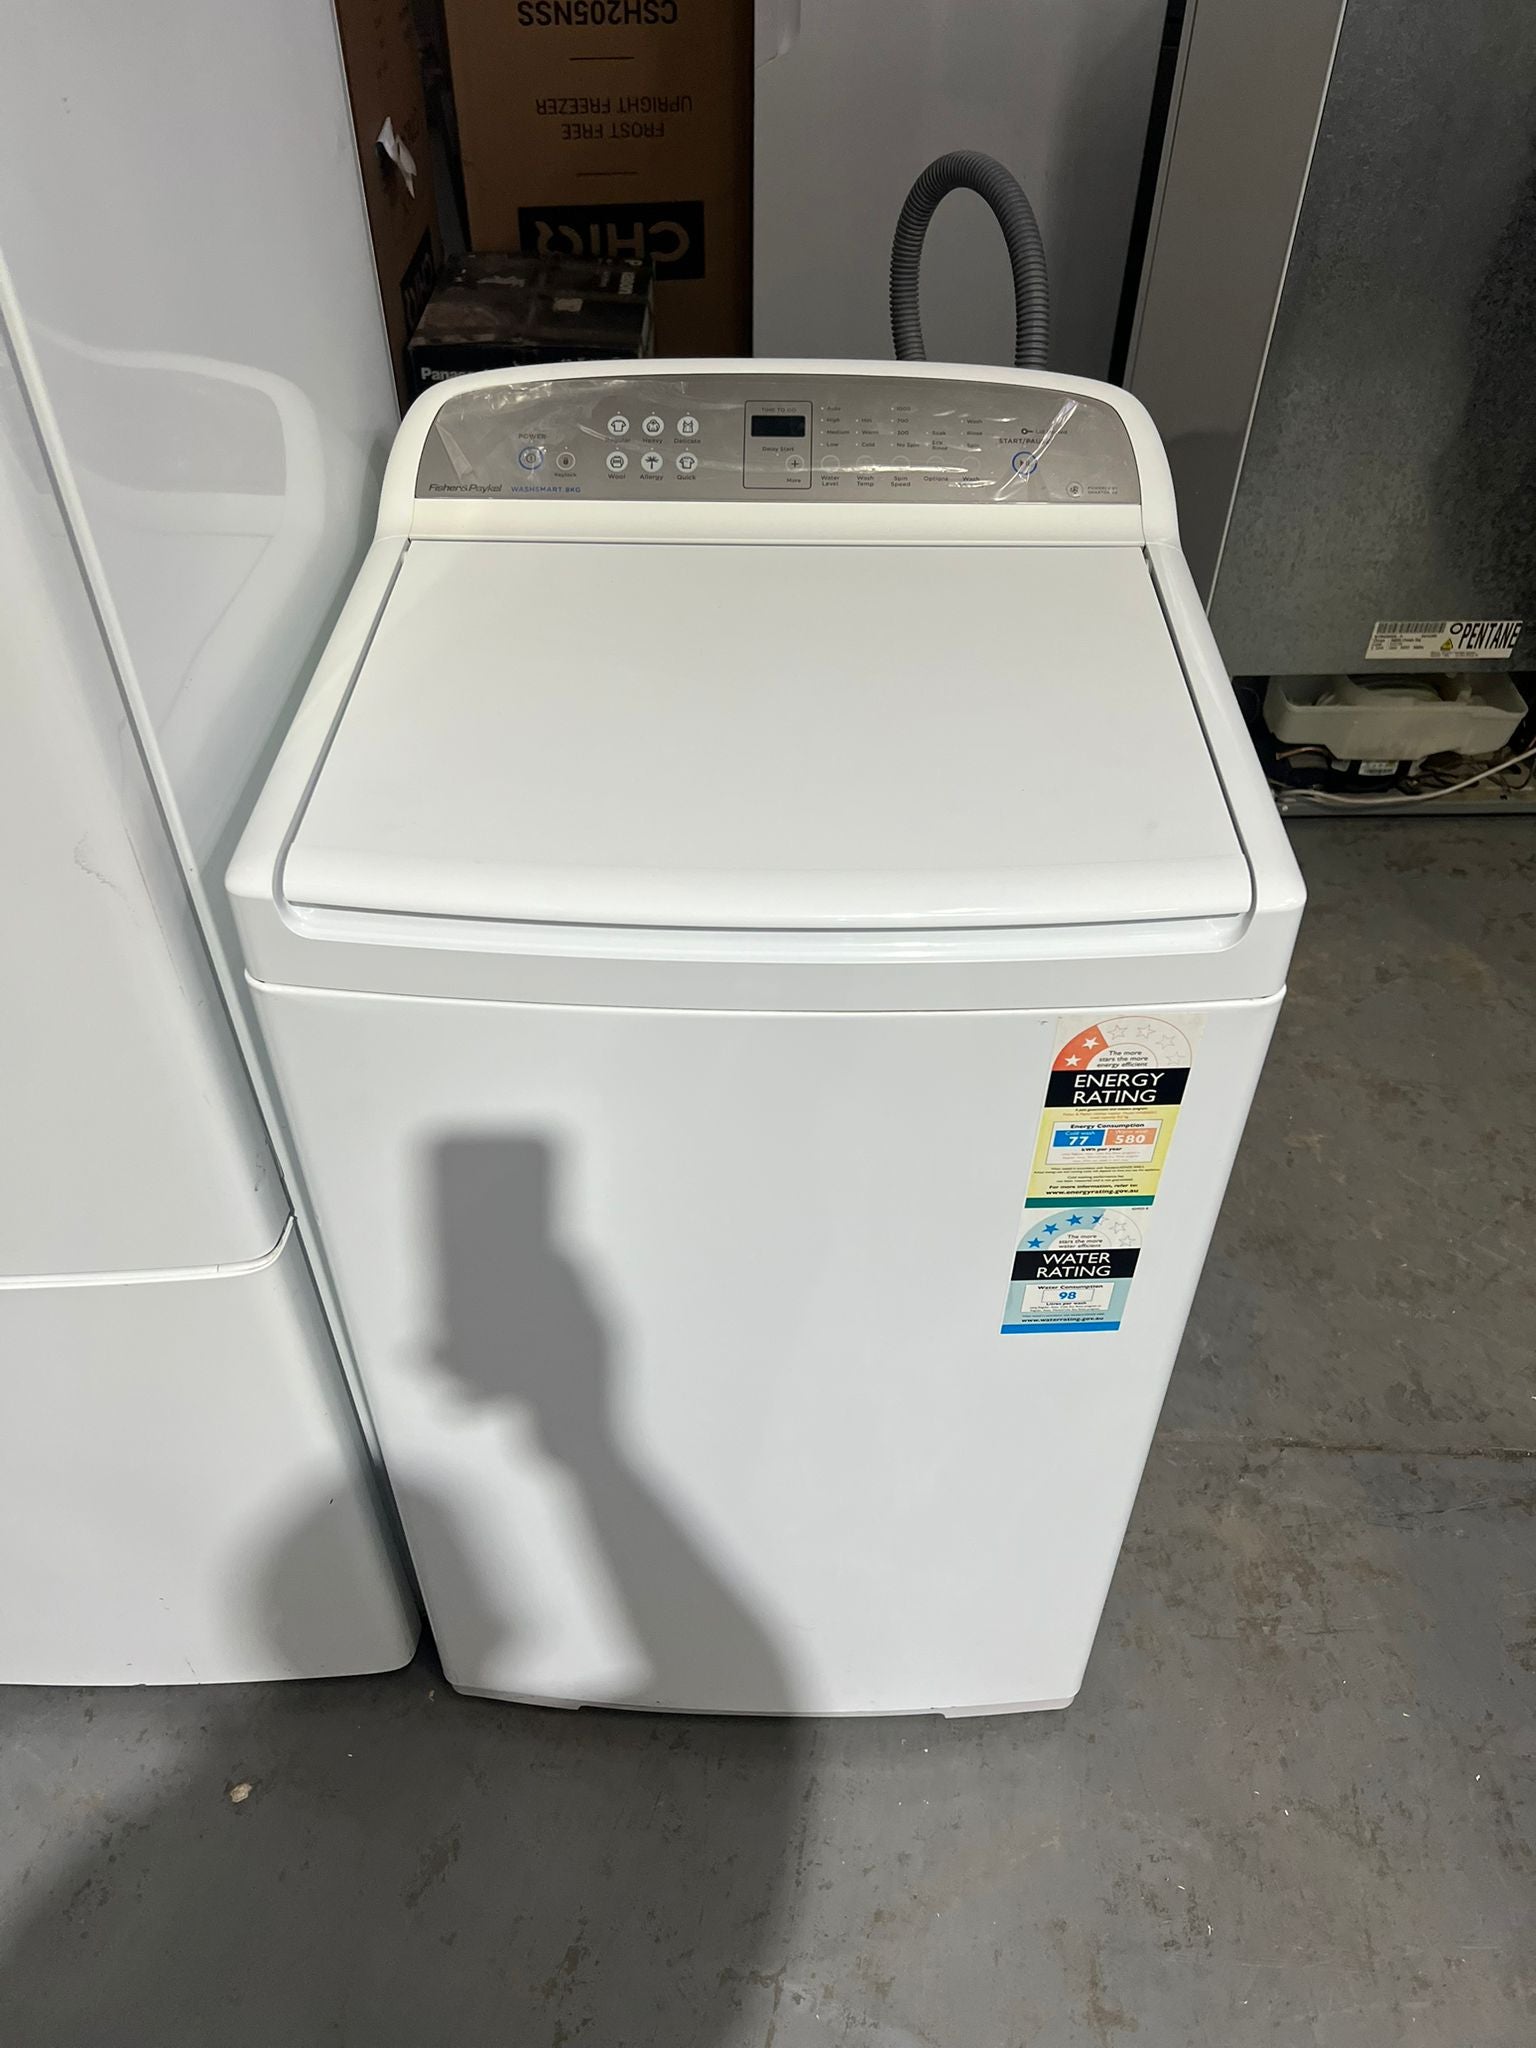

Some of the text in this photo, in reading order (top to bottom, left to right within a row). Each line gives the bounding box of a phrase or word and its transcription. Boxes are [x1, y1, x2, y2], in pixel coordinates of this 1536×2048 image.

[518, 0, 679, 26] CSH205NSS
[536, 95, 693, 116] UPRIGHT FREEZER
[561, 122, 665, 140] FROST FREE
[1458, 622, 1522, 650] PENTANE
[1074, 1072, 1165, 1088] ENERGY
[1072, 1089, 1157, 1104] RATING
[1068, 1136, 1089, 1146] 77
[1114, 1134, 1146, 1144] 580
[1043, 1252, 1111, 1264] WATER
[1036, 1266, 1112, 1278] RATING
[1058, 1291, 1077, 1300] 98
